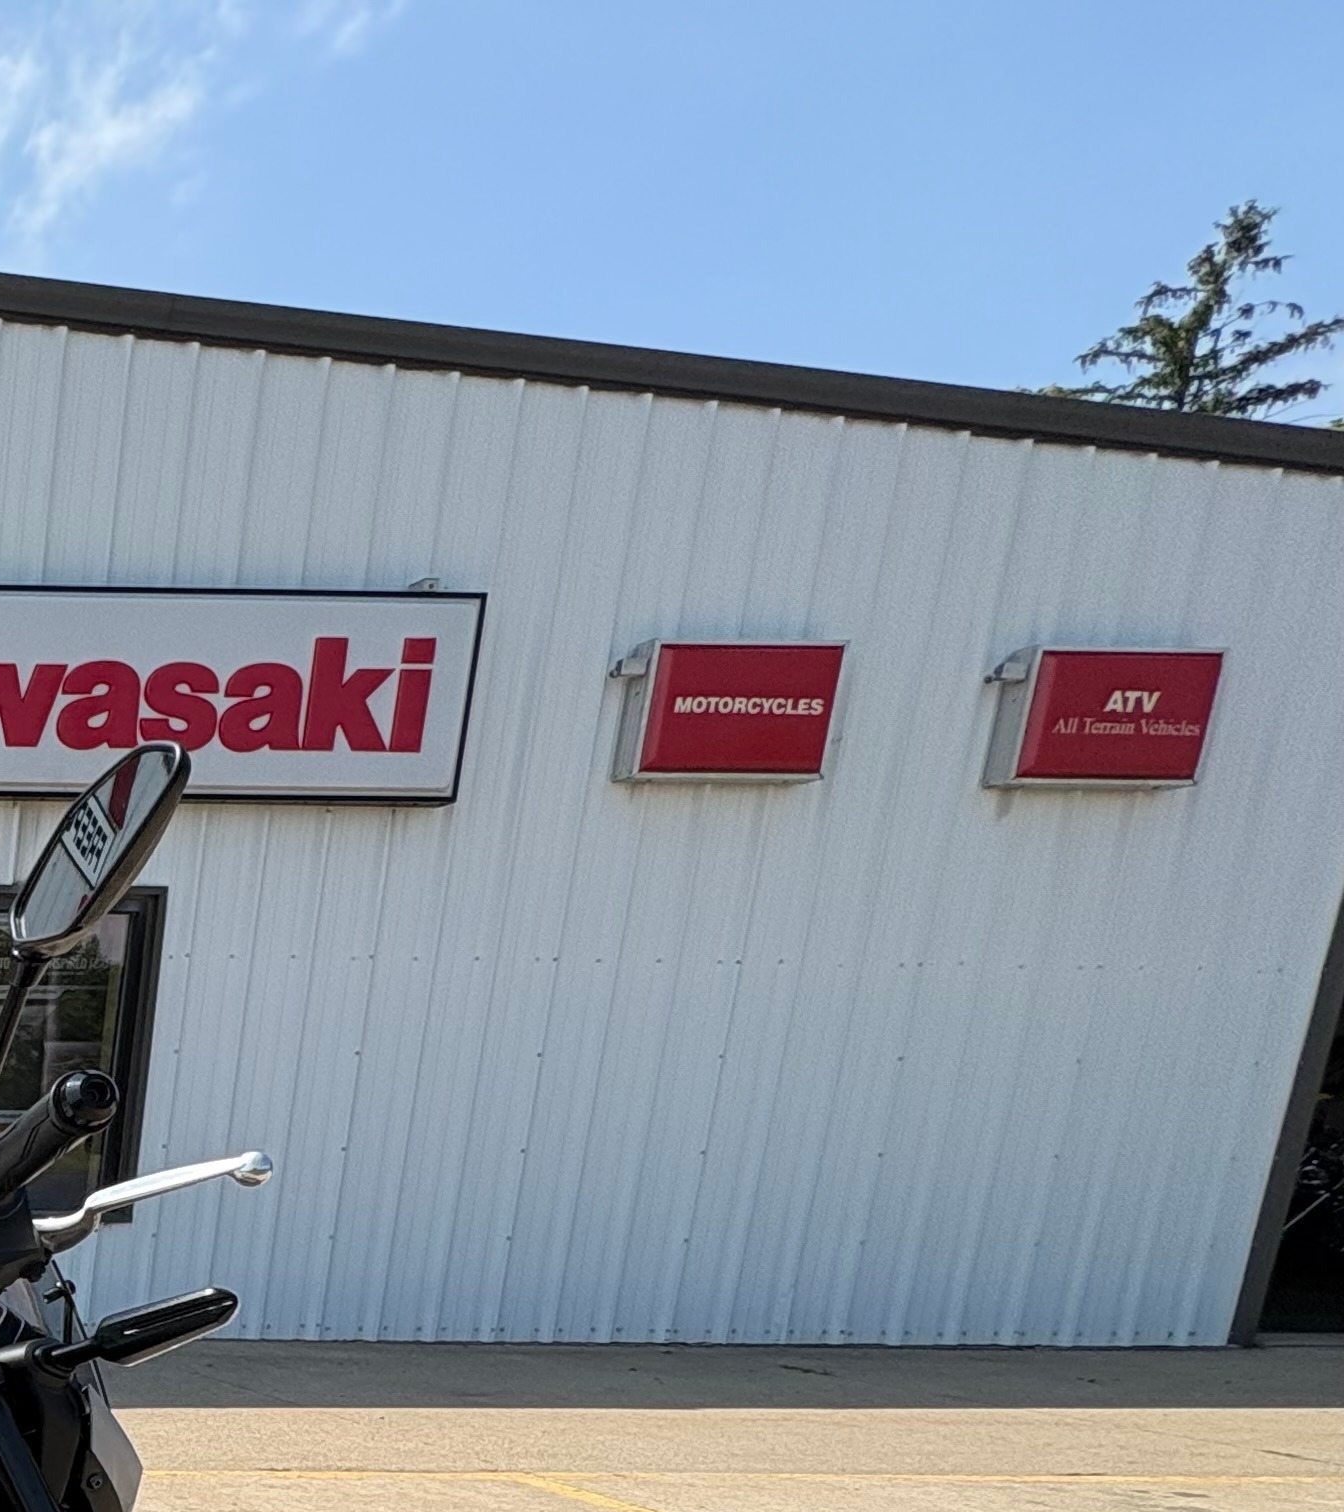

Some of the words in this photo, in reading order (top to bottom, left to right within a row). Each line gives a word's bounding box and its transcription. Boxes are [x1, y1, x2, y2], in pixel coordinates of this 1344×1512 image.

[673, 696, 825, 716] MOTORCYCLES
[1103, 690, 1161, 713] ATV
[1052, 717, 1079, 734] All
[1083, 717, 1135, 735] Terrain
[1140, 719, 1201, 736] Vehicles
